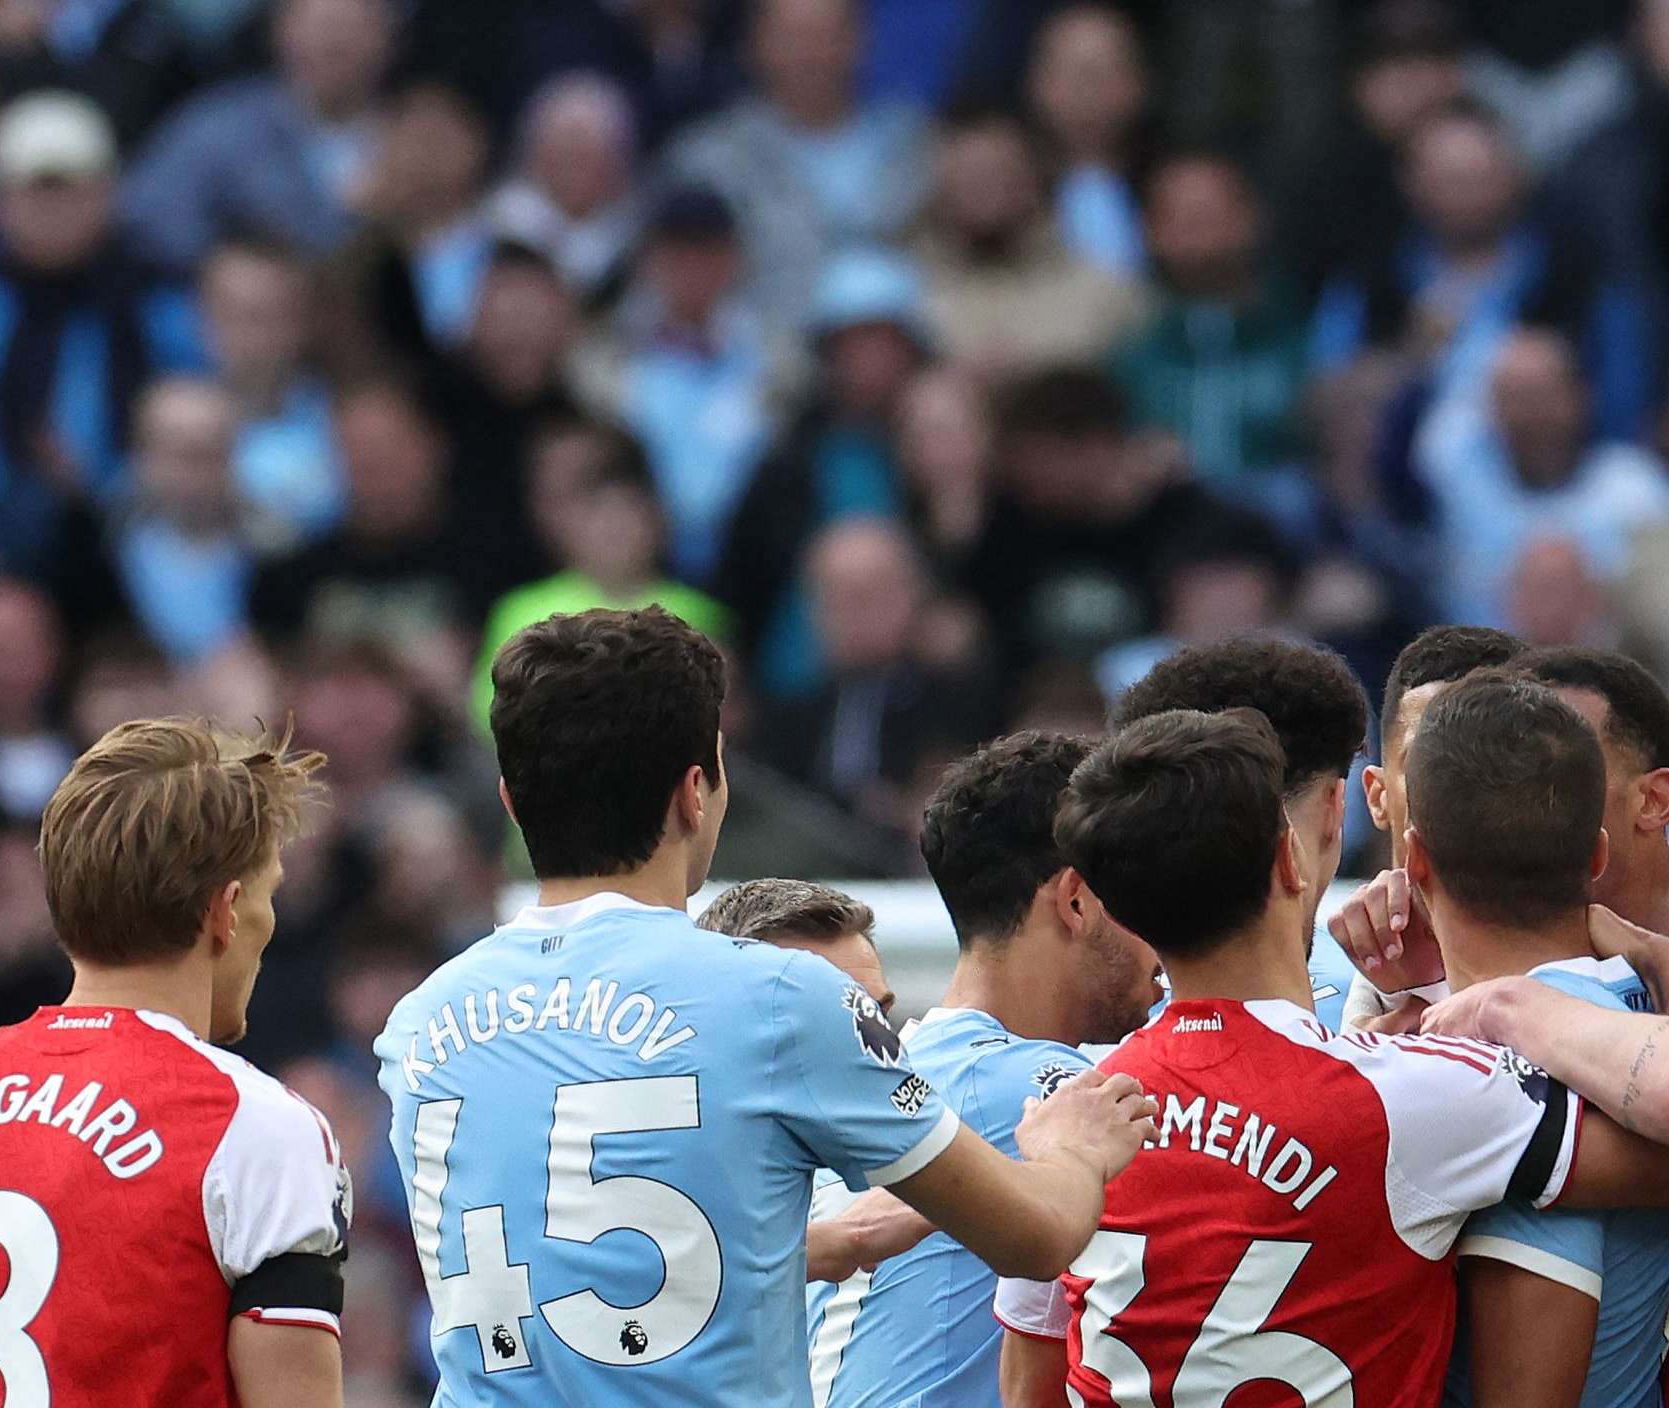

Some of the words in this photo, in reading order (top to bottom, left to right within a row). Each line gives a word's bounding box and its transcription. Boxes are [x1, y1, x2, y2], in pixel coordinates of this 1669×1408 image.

[540, 934, 566, 955] CITY
[46, 1011, 114, 1030] Arsenal
[1172, 1011, 1223, 1034] Arsenal
[401, 977, 697, 1091] KHUSANOV
[412, 1074, 724, 1375] 45
